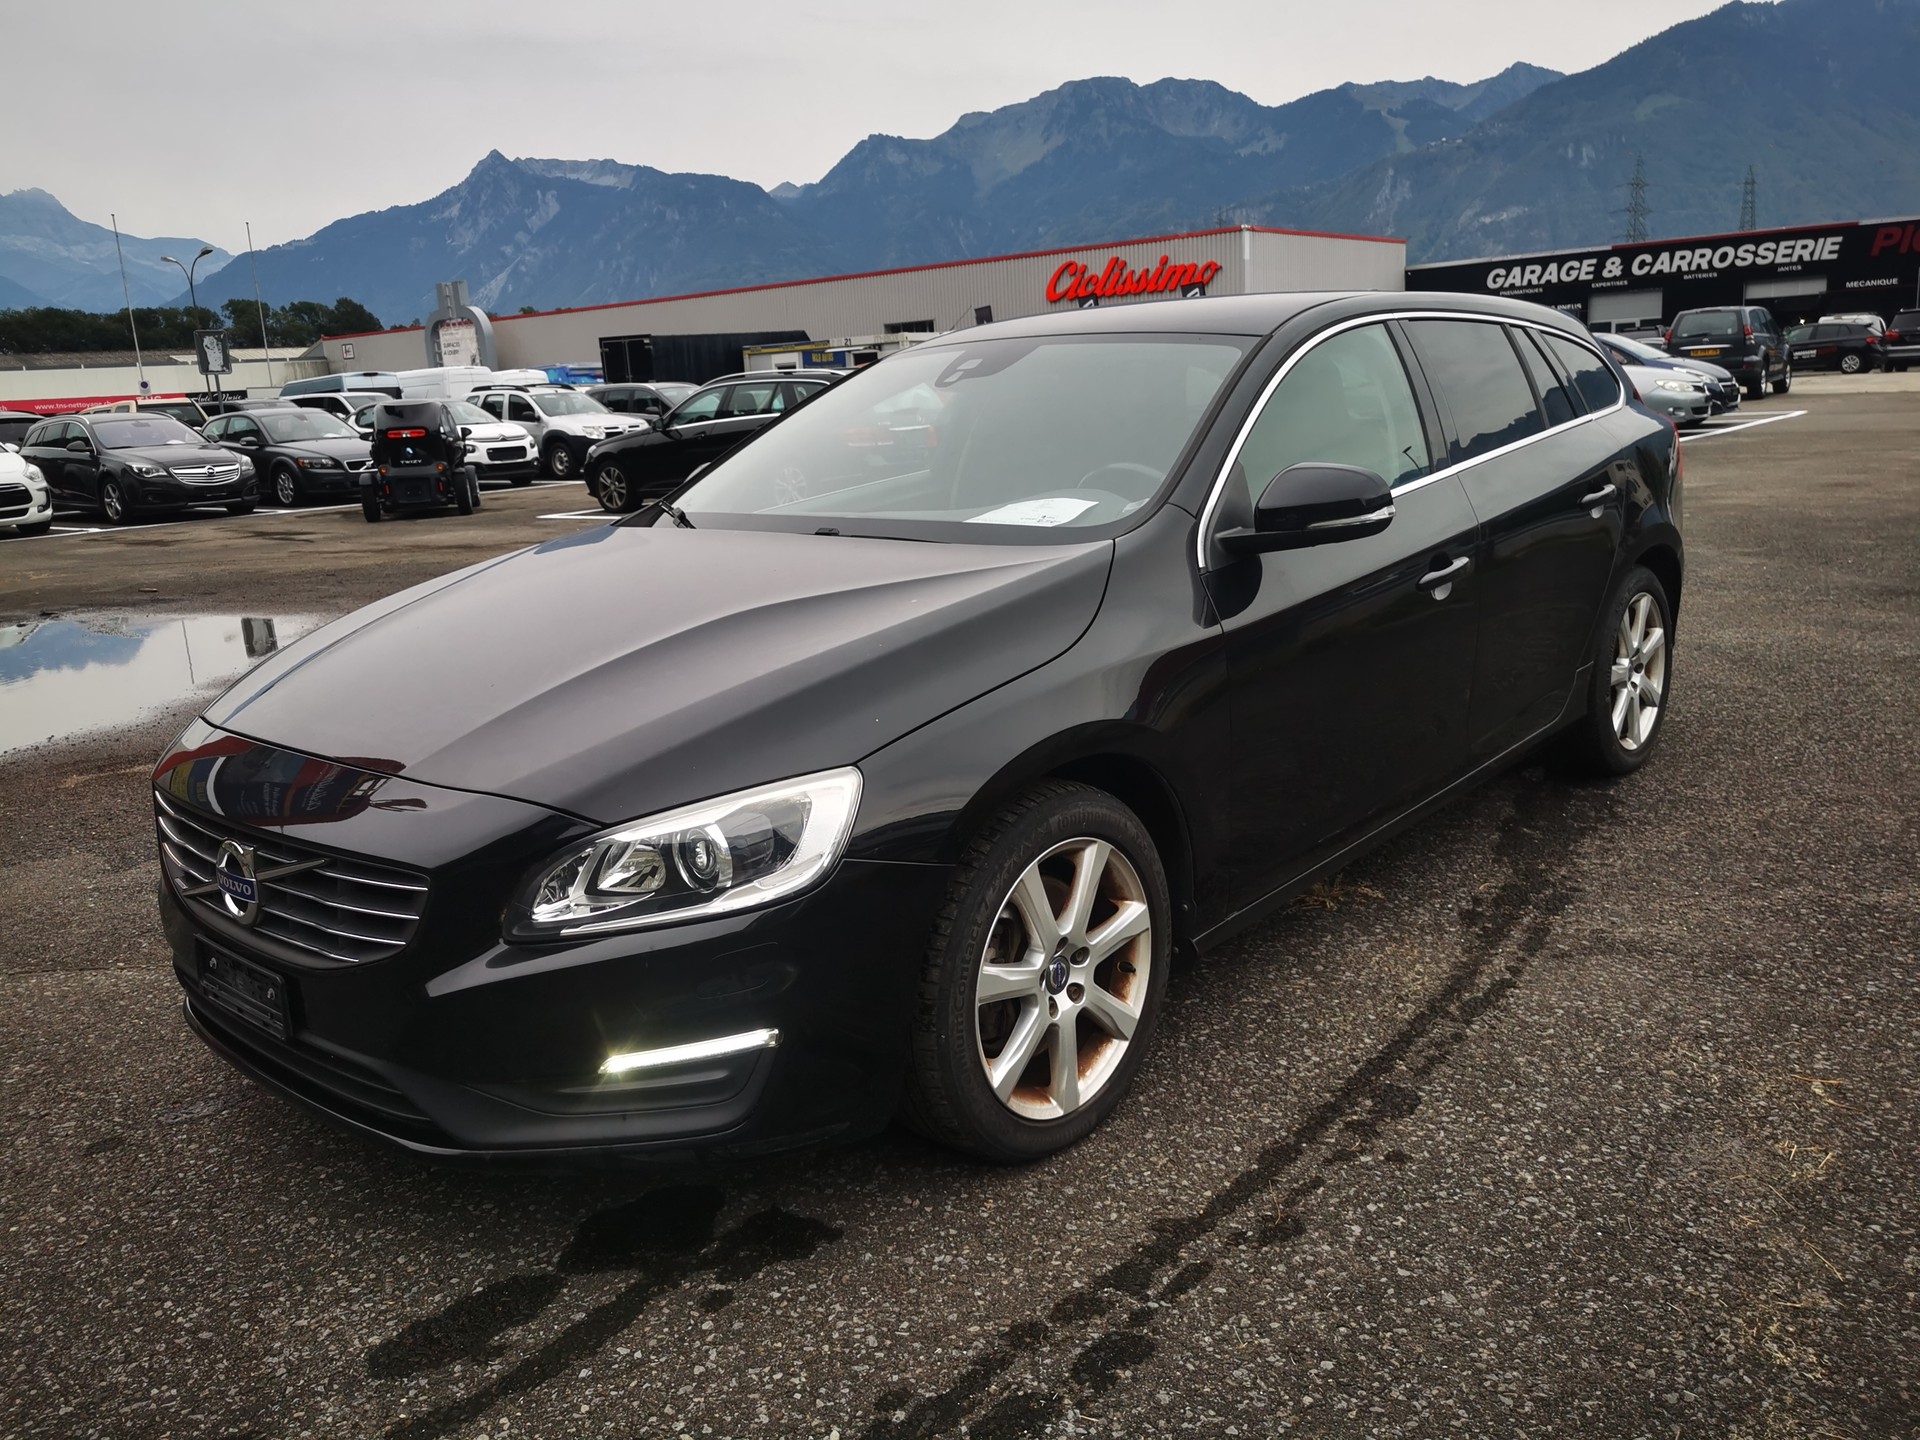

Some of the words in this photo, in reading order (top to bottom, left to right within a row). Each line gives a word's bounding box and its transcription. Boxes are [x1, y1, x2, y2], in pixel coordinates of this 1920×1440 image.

[1486, 258, 1598, 290] GARAGE
[1602, 256, 1624, 278] &
[1631, 236, 1844, 277] CARROSSERIE
[1777, 264, 1802, 272] JANTES
[1046, 255, 1222, 303] Ciclissimo
[1683, 272, 1718, 280] BATTERIES
[1591, 280, 1628, 289] EXPERTISES
[1845, 277, 1898, 289] MECANIQUE
[1499, 287, 1543, 296] PNEUMATIQUES
[844, 338, 852, 346] 21
[217, 872, 252, 896] VOLVO
